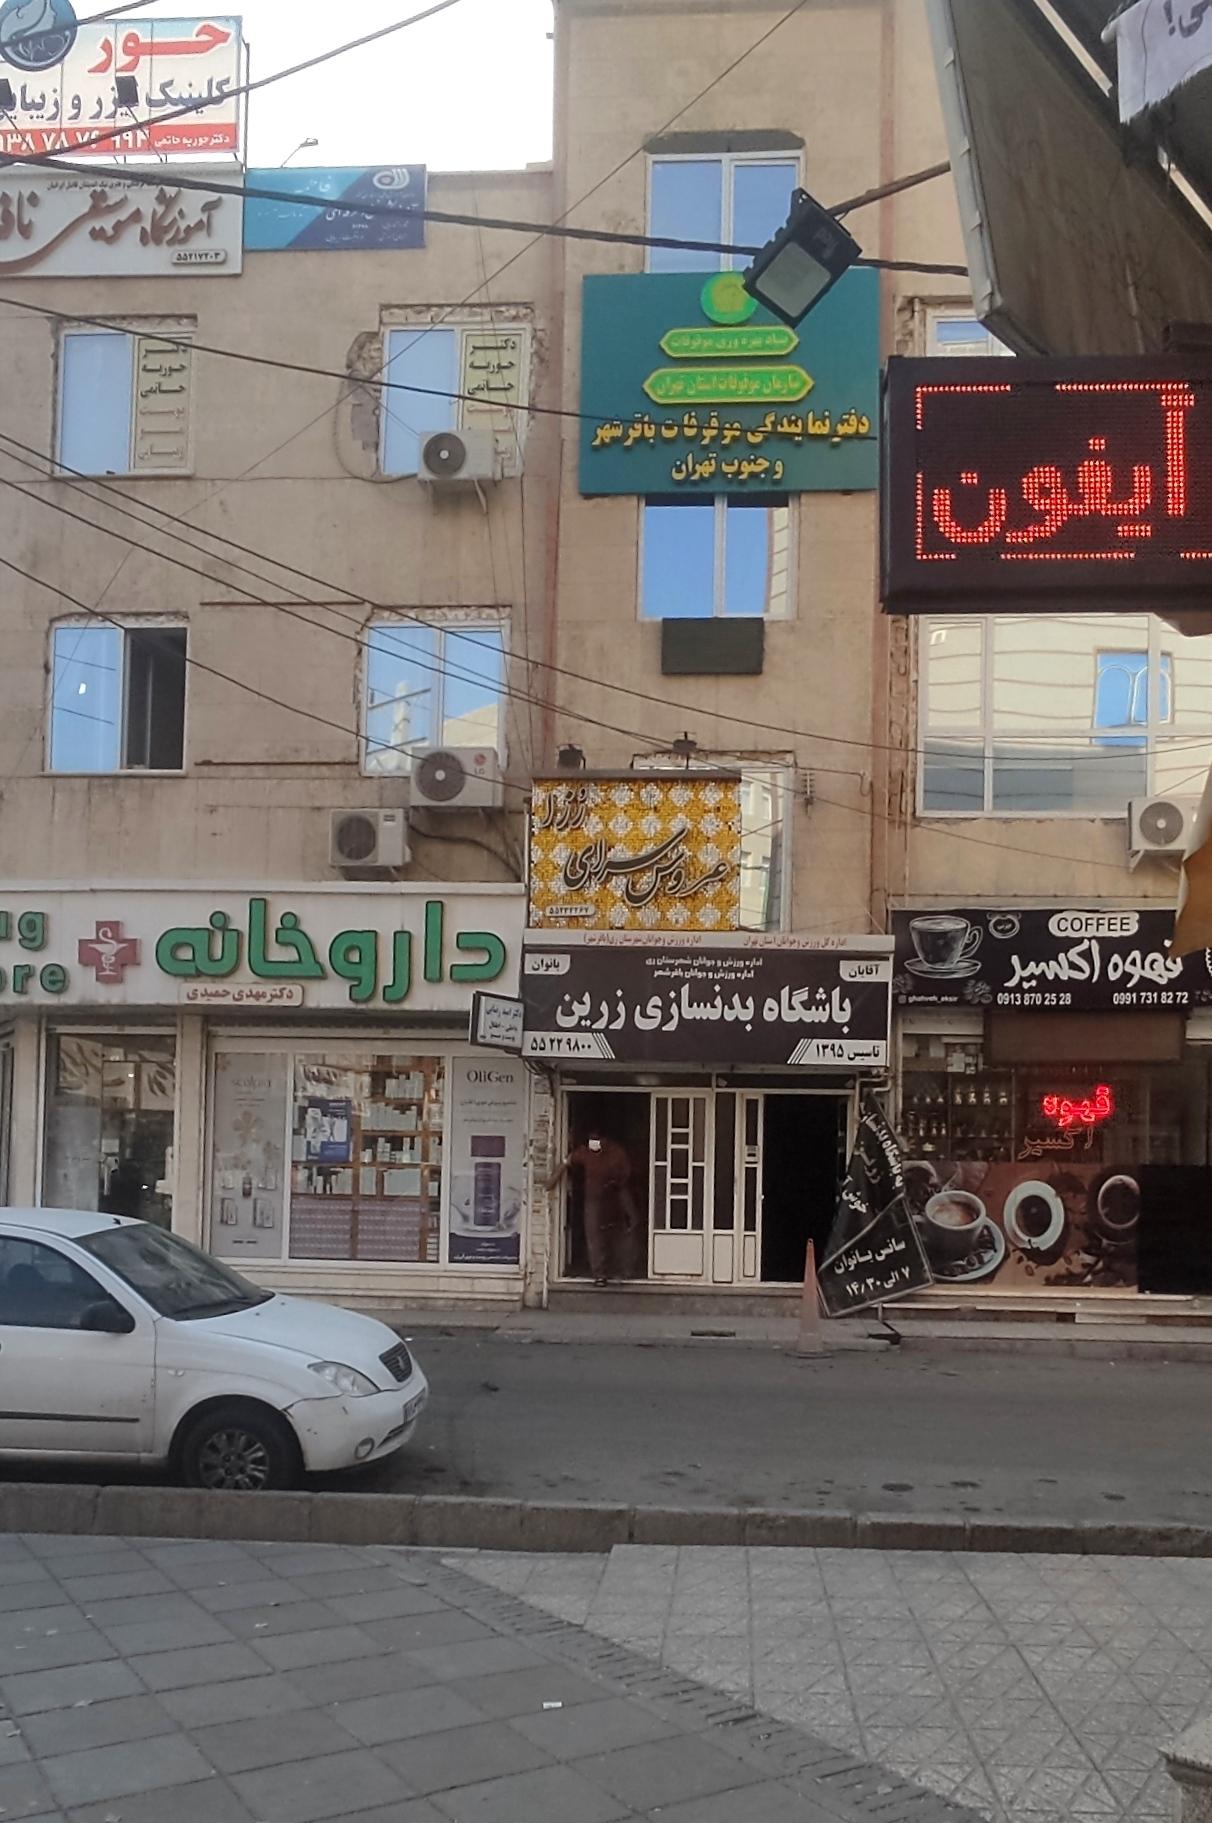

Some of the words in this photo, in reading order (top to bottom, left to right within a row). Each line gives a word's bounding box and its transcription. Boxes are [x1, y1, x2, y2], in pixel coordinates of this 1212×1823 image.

[87, 23, 232, 74] حور
[145, 76, 231, 114] کلینیک
[67, 94, 82, 121] و
[154, 136, 181, 148] حاتمی
[181, 136, 209, 148] حوریه
[209, 133, 230, 146] دکتر
[139, 187, 222, 247] آموزشگاه
[470, 338, 517, 355] دکتر
[141, 363, 187, 377] حوریه
[468, 360, 516, 374] حوریه
[140, 381, 187, 398] حاتمی
[467, 379, 515, 396] حاتمی
[834, 408, 870, 442] دفتر
[671, 452, 717, 480] تهران
[721, 452, 770, 478] جنوب
[773, 456, 784, 480] و
[932, 393, 1194, 543] آیفون
[563, 828, 690, 891] سرای
[1057, 917, 1131, 932] COFFEE
[155, 897, 507, 1001] داروخانه
[531, 958, 561, 972] بانوان
[722, 956, 744, 968] ورزش
[1003, 938, 1100, 990] اکسیر
[713, 968, 735, 980] ورزش
[848, 964, 880, 978] آقایان
[186, 988, 232, 1001] حمیدی
[232, 988, 267, 1002] مهدی
[267, 988, 295, 1003] دکتر
[997, 993, 1022, 1006] 0913
[1023, 993, 1042, 1006] 870
[1044, 993, 1057, 1006] 25
[1059, 993, 1072, 1006] 28
[1113, 992, 1137, 1005] 0991
[1140, 992, 1158, 1004] 731
[1160, 992, 1174, 1004] 82
[1175, 992, 1189, 1004] 72
[555, 988, 627, 1030] زرین
[633, 983, 755, 1031] بدنسازی
[762, 984, 852, 1035] باشگاه
[530, 1037, 546, 1052] ۵۵
[565, 1037, 592, 1052] ۹۸۰۰
[816, 1043, 844, 1058] ۱۳۹۵
[847, 1045, 880, 1062] تاسیس
[467, 1069, 514, 1084] OliGen
[1043, 1085, 1114, 1127] قهوه
[1017, 1126, 1094, 1160] اکسیر
[874, 1238, 906, 1262] سانس
[834, 1248, 875, 1274] بانوان
[883, 1270, 900, 1289] الی
[901, 1266, 910, 1280] ۷
